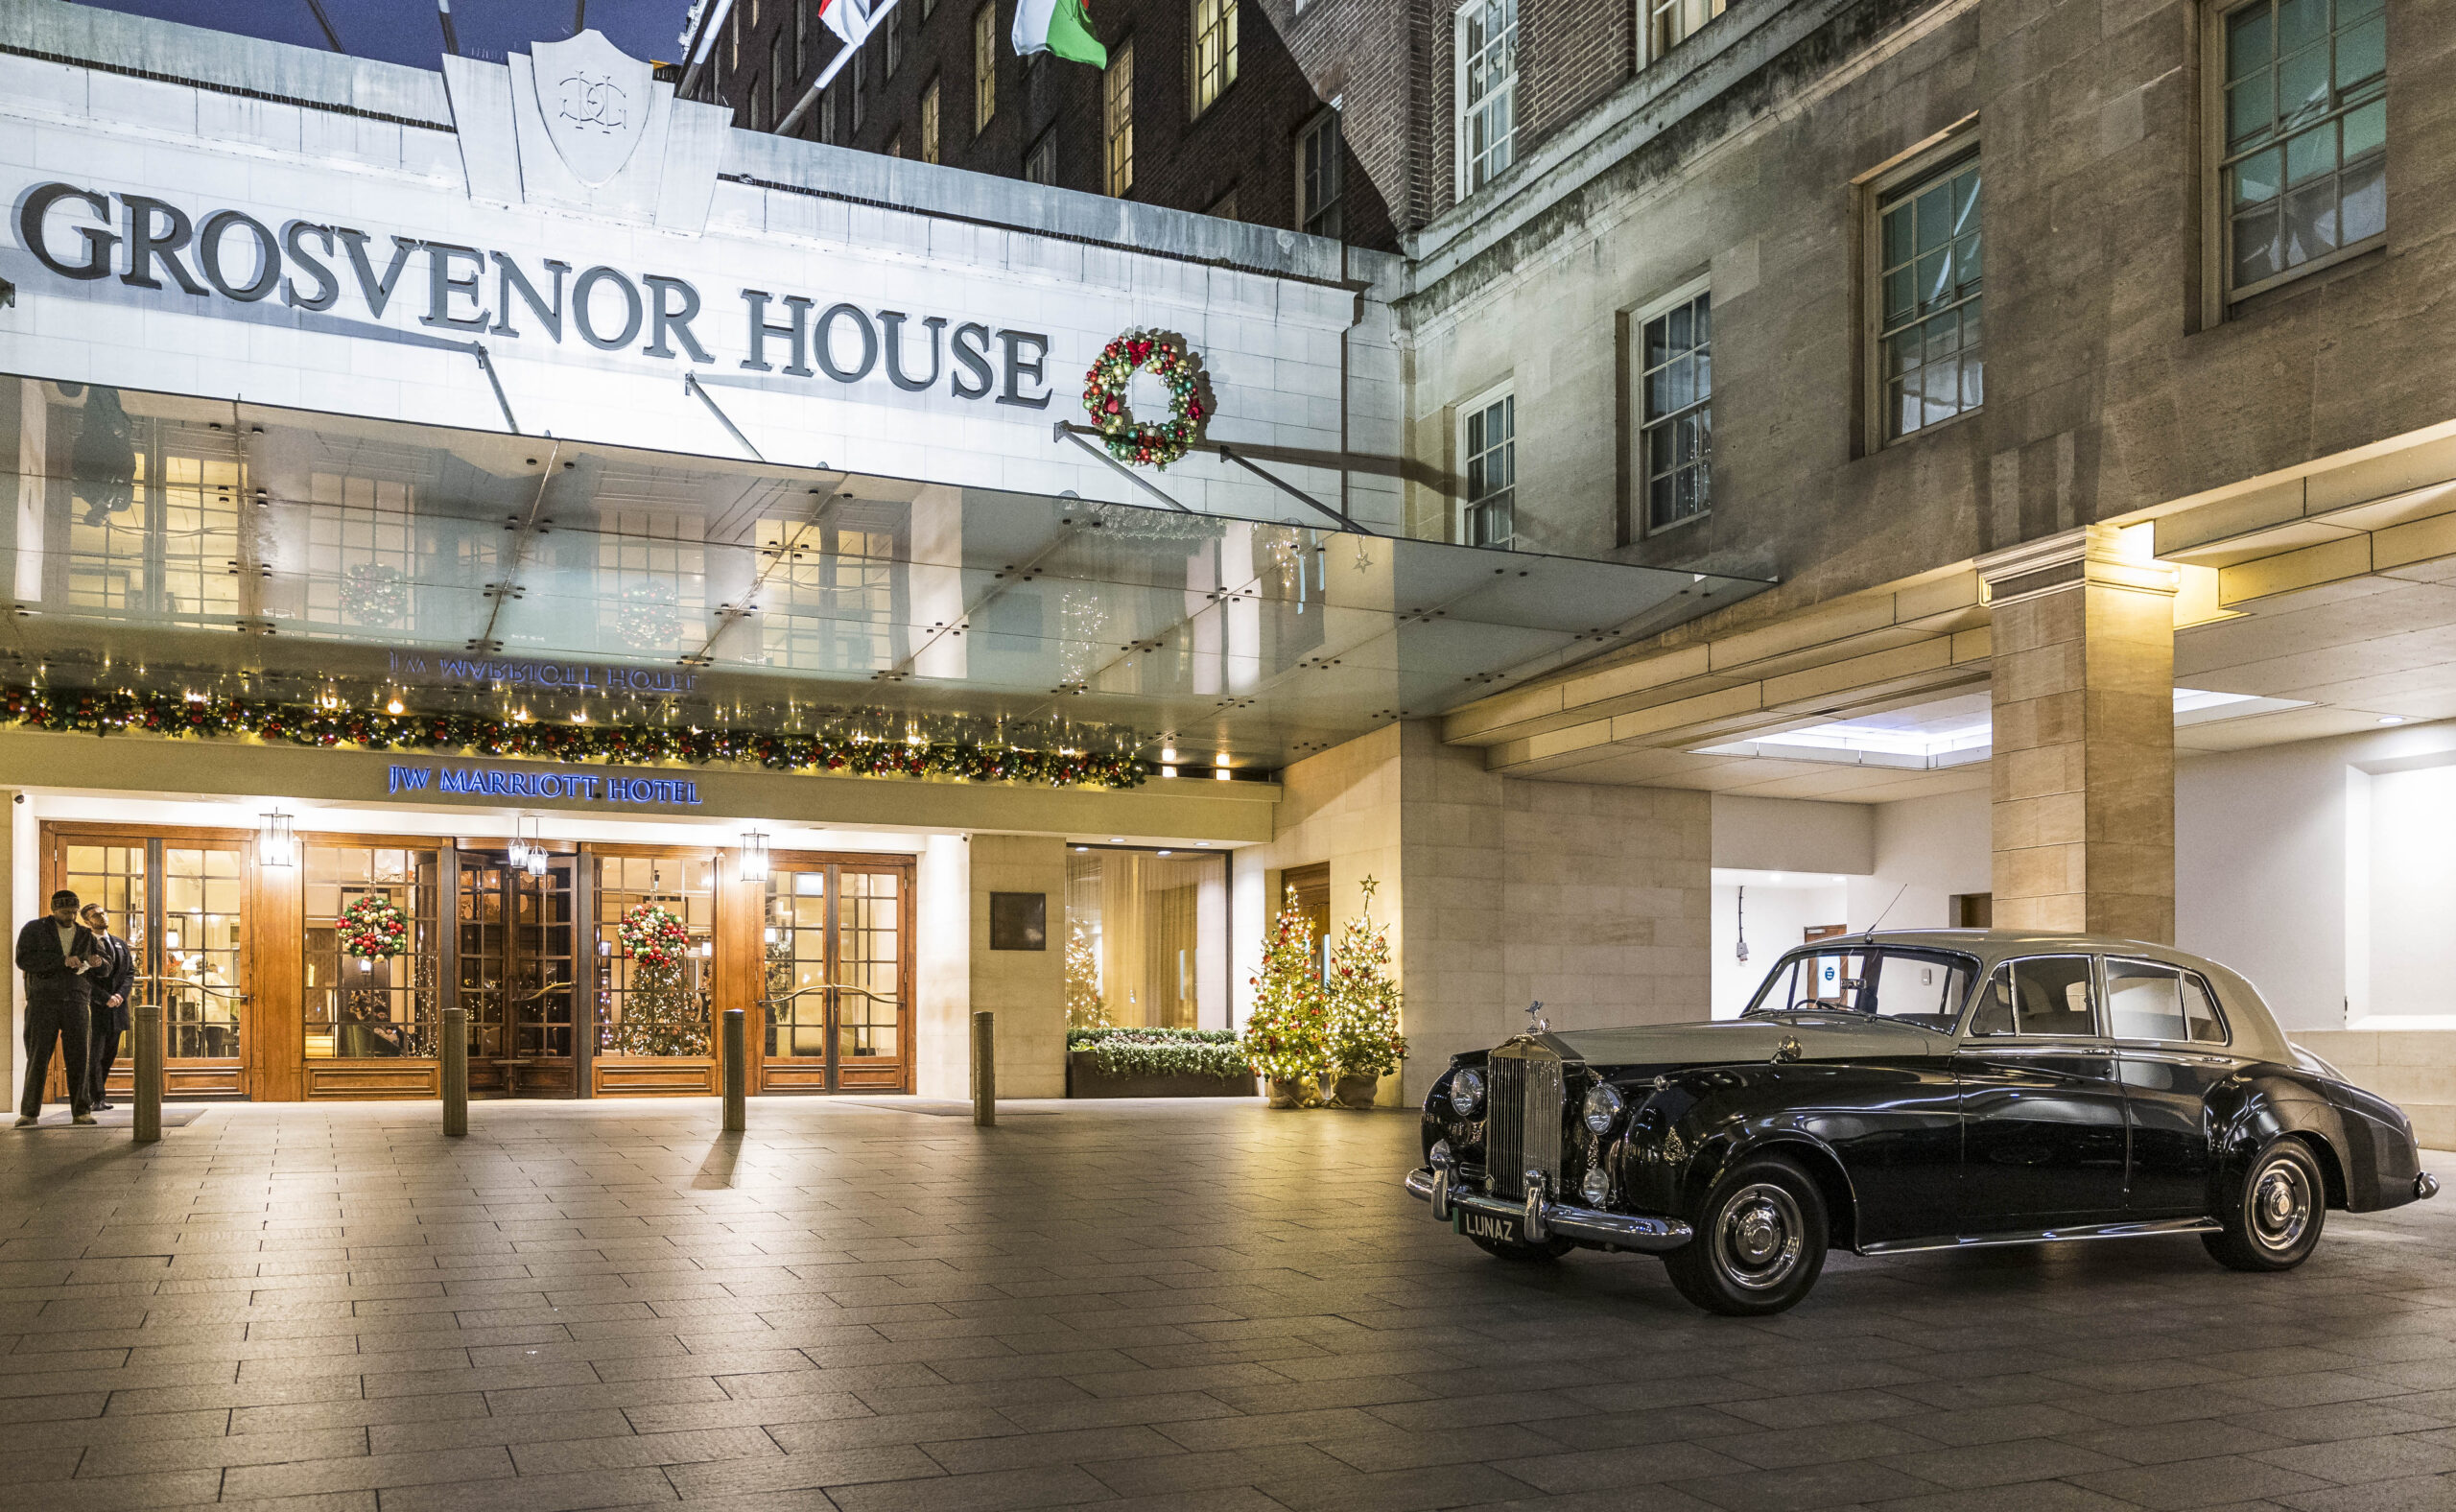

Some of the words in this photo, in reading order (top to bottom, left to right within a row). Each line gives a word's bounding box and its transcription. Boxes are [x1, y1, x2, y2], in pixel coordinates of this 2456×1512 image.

[20, 181, 716, 364] GROSVENOR
[740, 289, 1053, 410] HOUSE
[389, 766, 431, 794] JW
[440, 768, 599, 799] MARRIOTT
[609, 777, 702, 804] HOTEL
[1466, 1214, 1513, 1241] LUNAZ
